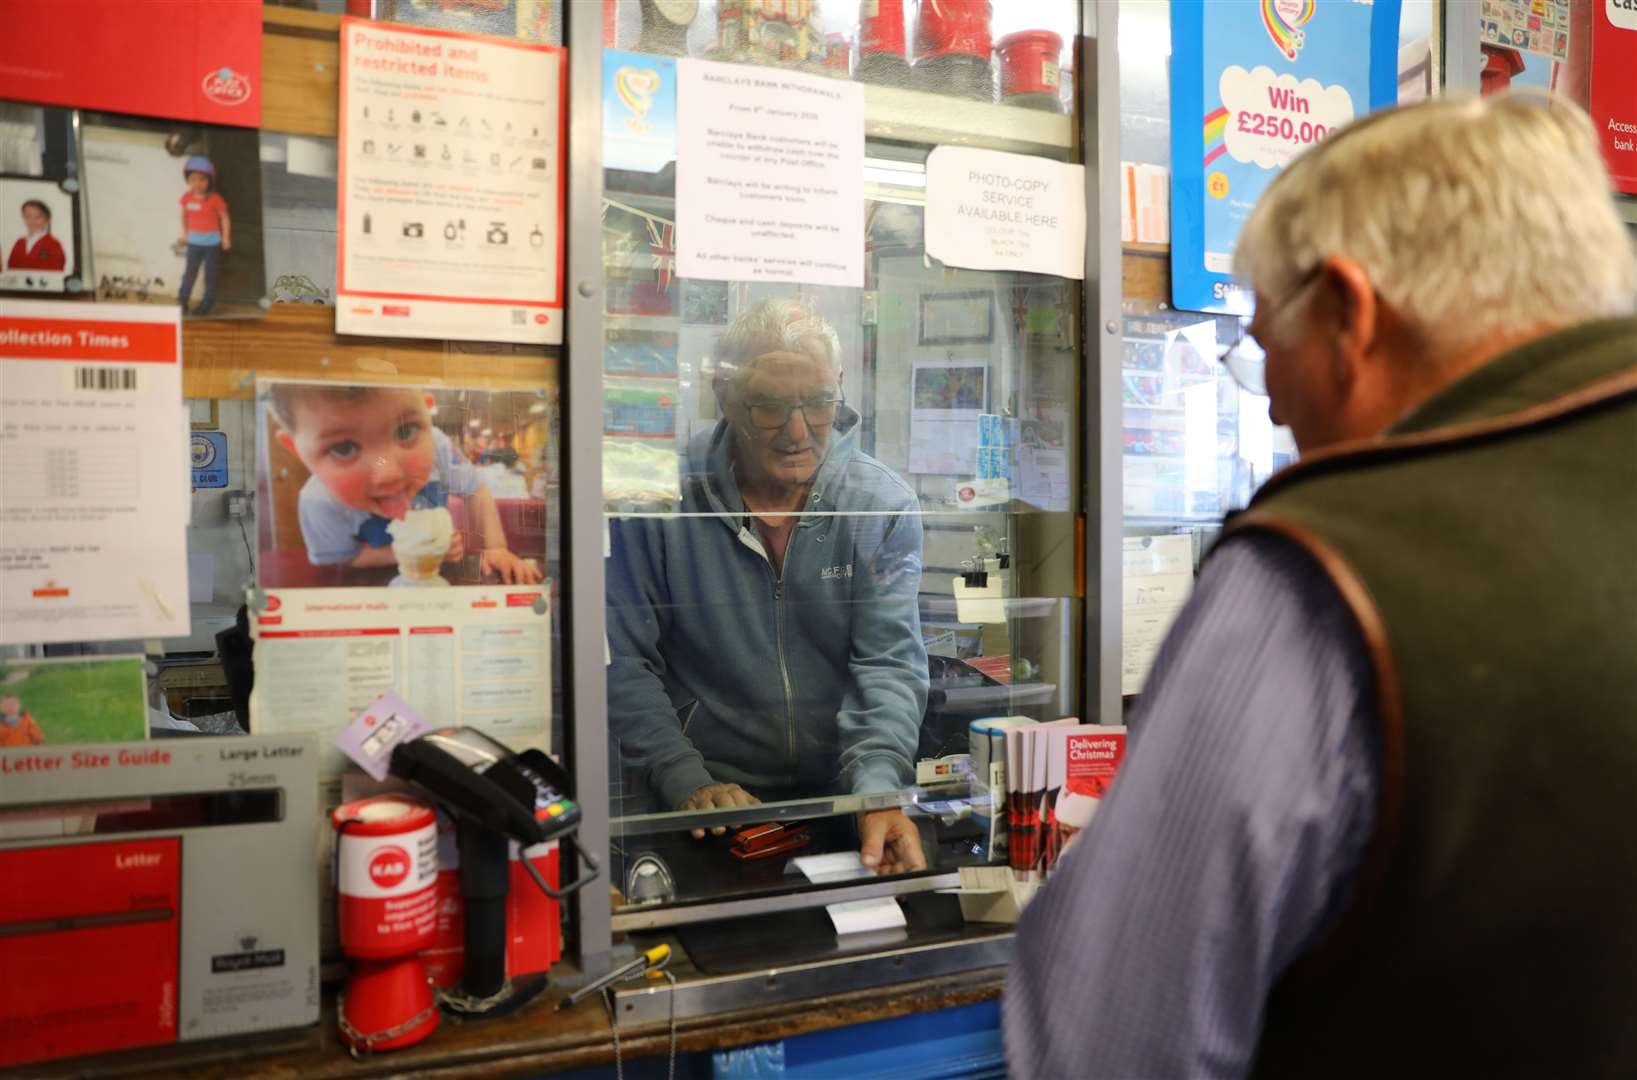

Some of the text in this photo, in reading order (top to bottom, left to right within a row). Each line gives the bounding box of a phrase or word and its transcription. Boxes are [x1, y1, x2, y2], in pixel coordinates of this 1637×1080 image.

[354, 32, 479, 62] Prohibited and
[353, 54, 489, 83] restricted items
[704, 74, 751, 87] BARCLAYS
[755, 80, 778, 89] BANK
[1268, 86, 1310, 114] Win
[730, 104, 751, 113] From
[767, 109, 798, 119] January
[708, 129, 743, 140] Barclays
[747, 133, 767, 141] Bank
[770, 137, 811, 146] customers
[830, 141, 838, 149] be
[1614, 135, 1633, 151] bank
[707, 142, 734, 150] unable
[748, 145, 784, 154] withdraw
[787, 148, 806, 156] cash
[828, 152, 839, 160] the
[721, 153, 751, 161] counter
[765, 157, 778, 165] any
[781, 158, 799, 166] Post
[708, 177, 742, 188] Barclays
[775, 185, 801, 194] writing
[814, 188, 838, 196] inform
[969, 172, 1050, 192] PHOTO-COPY
[740, 192, 783, 202] customers
[983, 191, 1033, 208] SERVICE
[705, 215, 840, 233] Cheque and cash deposits will be
[958, 206, 1058, 228] AVAILABLE HERE
[696, 252, 707, 260] All
[710, 254, 730, 262] other
[764, 257, 797, 266] services
[801, 259, 813, 267] will
[815, 261, 847, 271] continue
[77, 330, 129, 348] Times
[219, 745, 304, 762] Large Letter
[1069, 738, 1117, 752] Delivering
[2, 749, 172, 774] Letter Size Guide
[1069, 749, 1115, 760] Christmas
[227, 772, 277, 786] 25mm
[115, 852, 163, 869] Letter
[372, 861, 405, 876] KAB
